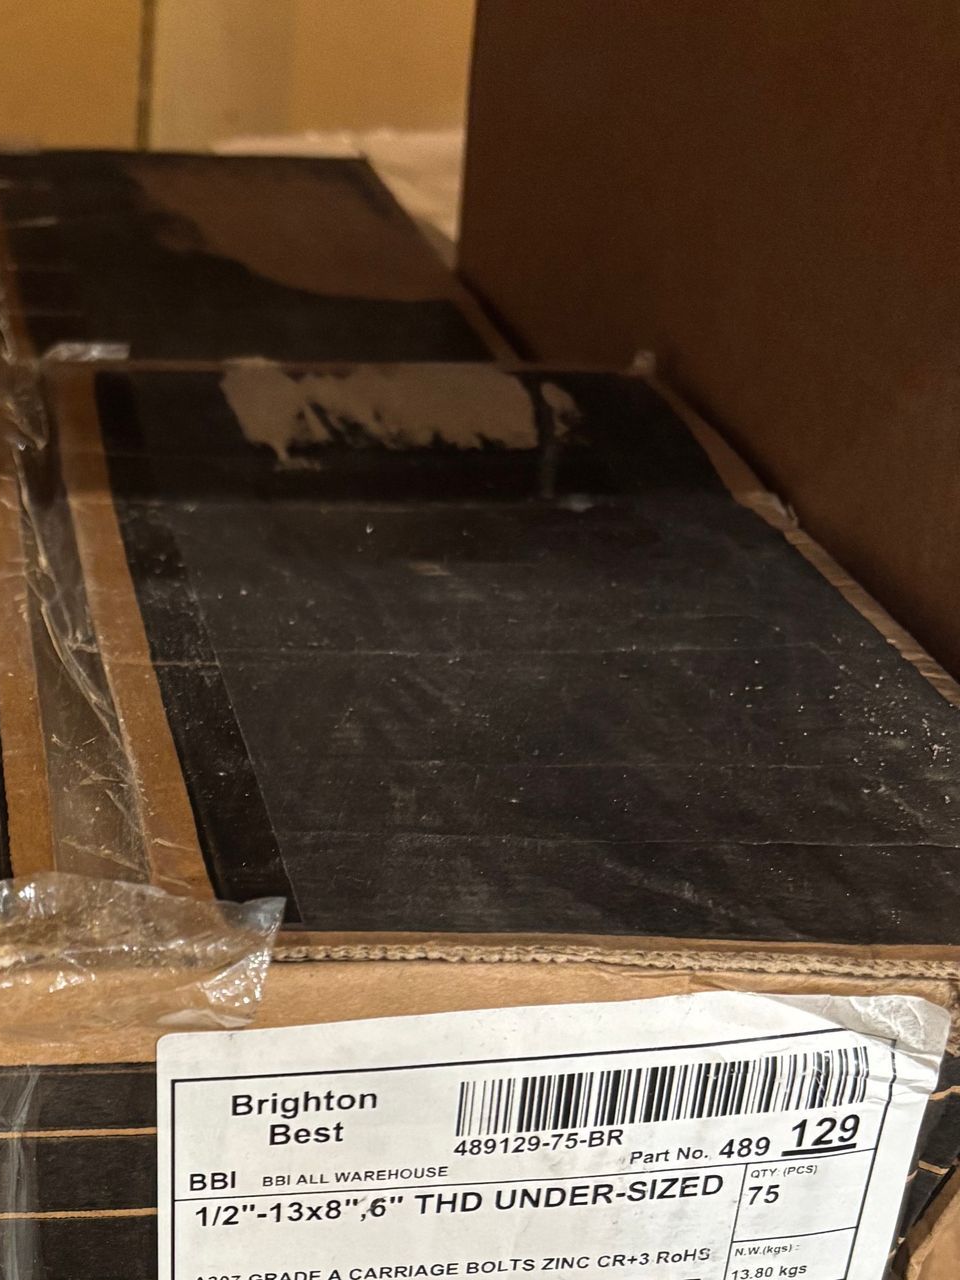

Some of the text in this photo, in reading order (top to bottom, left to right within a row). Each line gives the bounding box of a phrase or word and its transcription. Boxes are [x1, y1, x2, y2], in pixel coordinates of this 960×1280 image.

[230, 1089, 378, 1119] Brighton
[269, 1122, 344, 1145] Best
[453, 1129, 624, 1157] 489129-75-BR
[630, 1113, 861, 1165] Part No. 489 129
[189, 1166, 449, 1192] BBI BBI ALL WAREHOUSE
[783, 1164, 818, 1177] (PCS)
[414, 1191, 482, 1215] THD
[494, 1174, 724, 1210] UNDER-SIZED
[748, 1184, 780, 1206] 75
[348, 1262, 459, 1280] CARRIAGE
[466, 1257, 535, 1275] BOLTS
[540, 1256, 590, 1271] ZINC
[597, 1252, 650, 1268] CR+3
[655, 1247, 711, 1265] RoHS
[731, 1264, 808, 1280] 13.80 kgs
